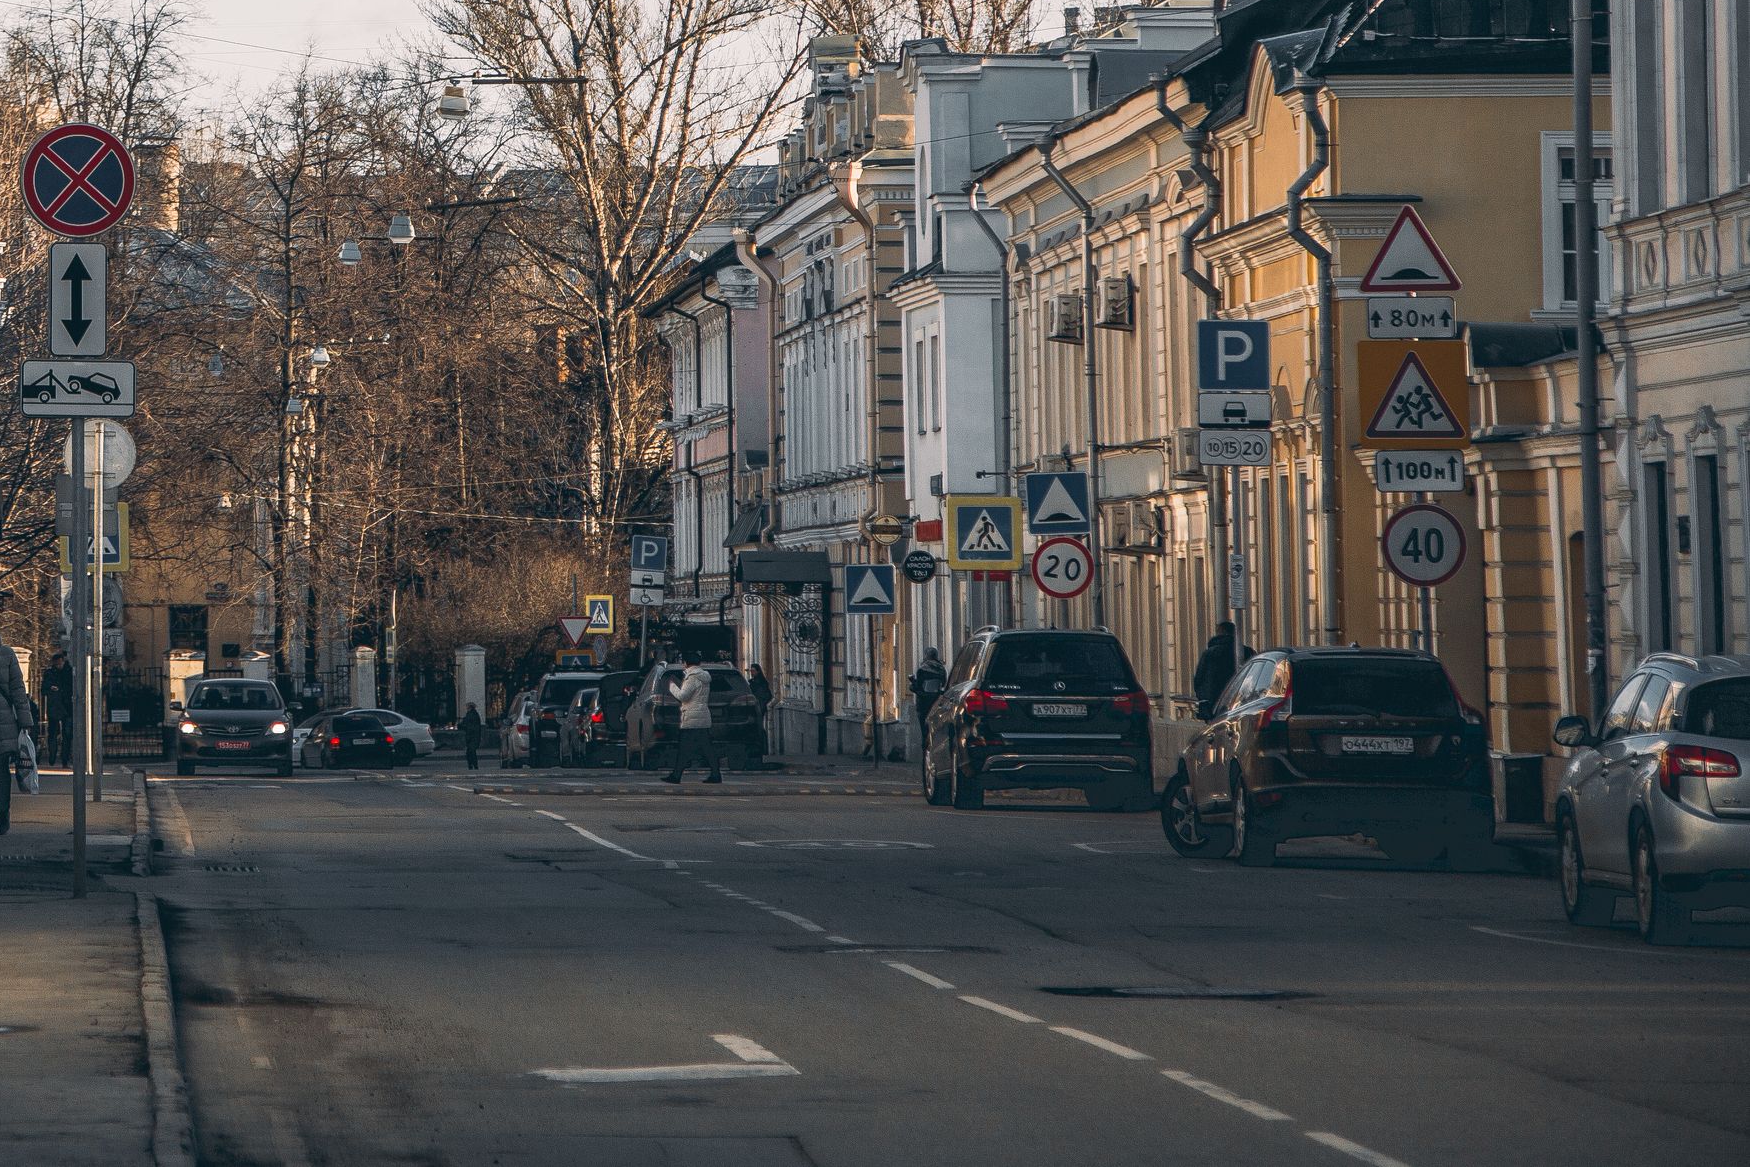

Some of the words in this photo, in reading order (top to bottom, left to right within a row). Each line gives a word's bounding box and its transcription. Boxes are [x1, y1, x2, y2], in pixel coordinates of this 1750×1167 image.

[1217, 330, 1253, 381] P
[1243, 441, 1263, 455] 20
[641, 541, 658, 565] P
[1401, 527, 1444, 563] 40
[1044, 554, 1081, 581] 20
